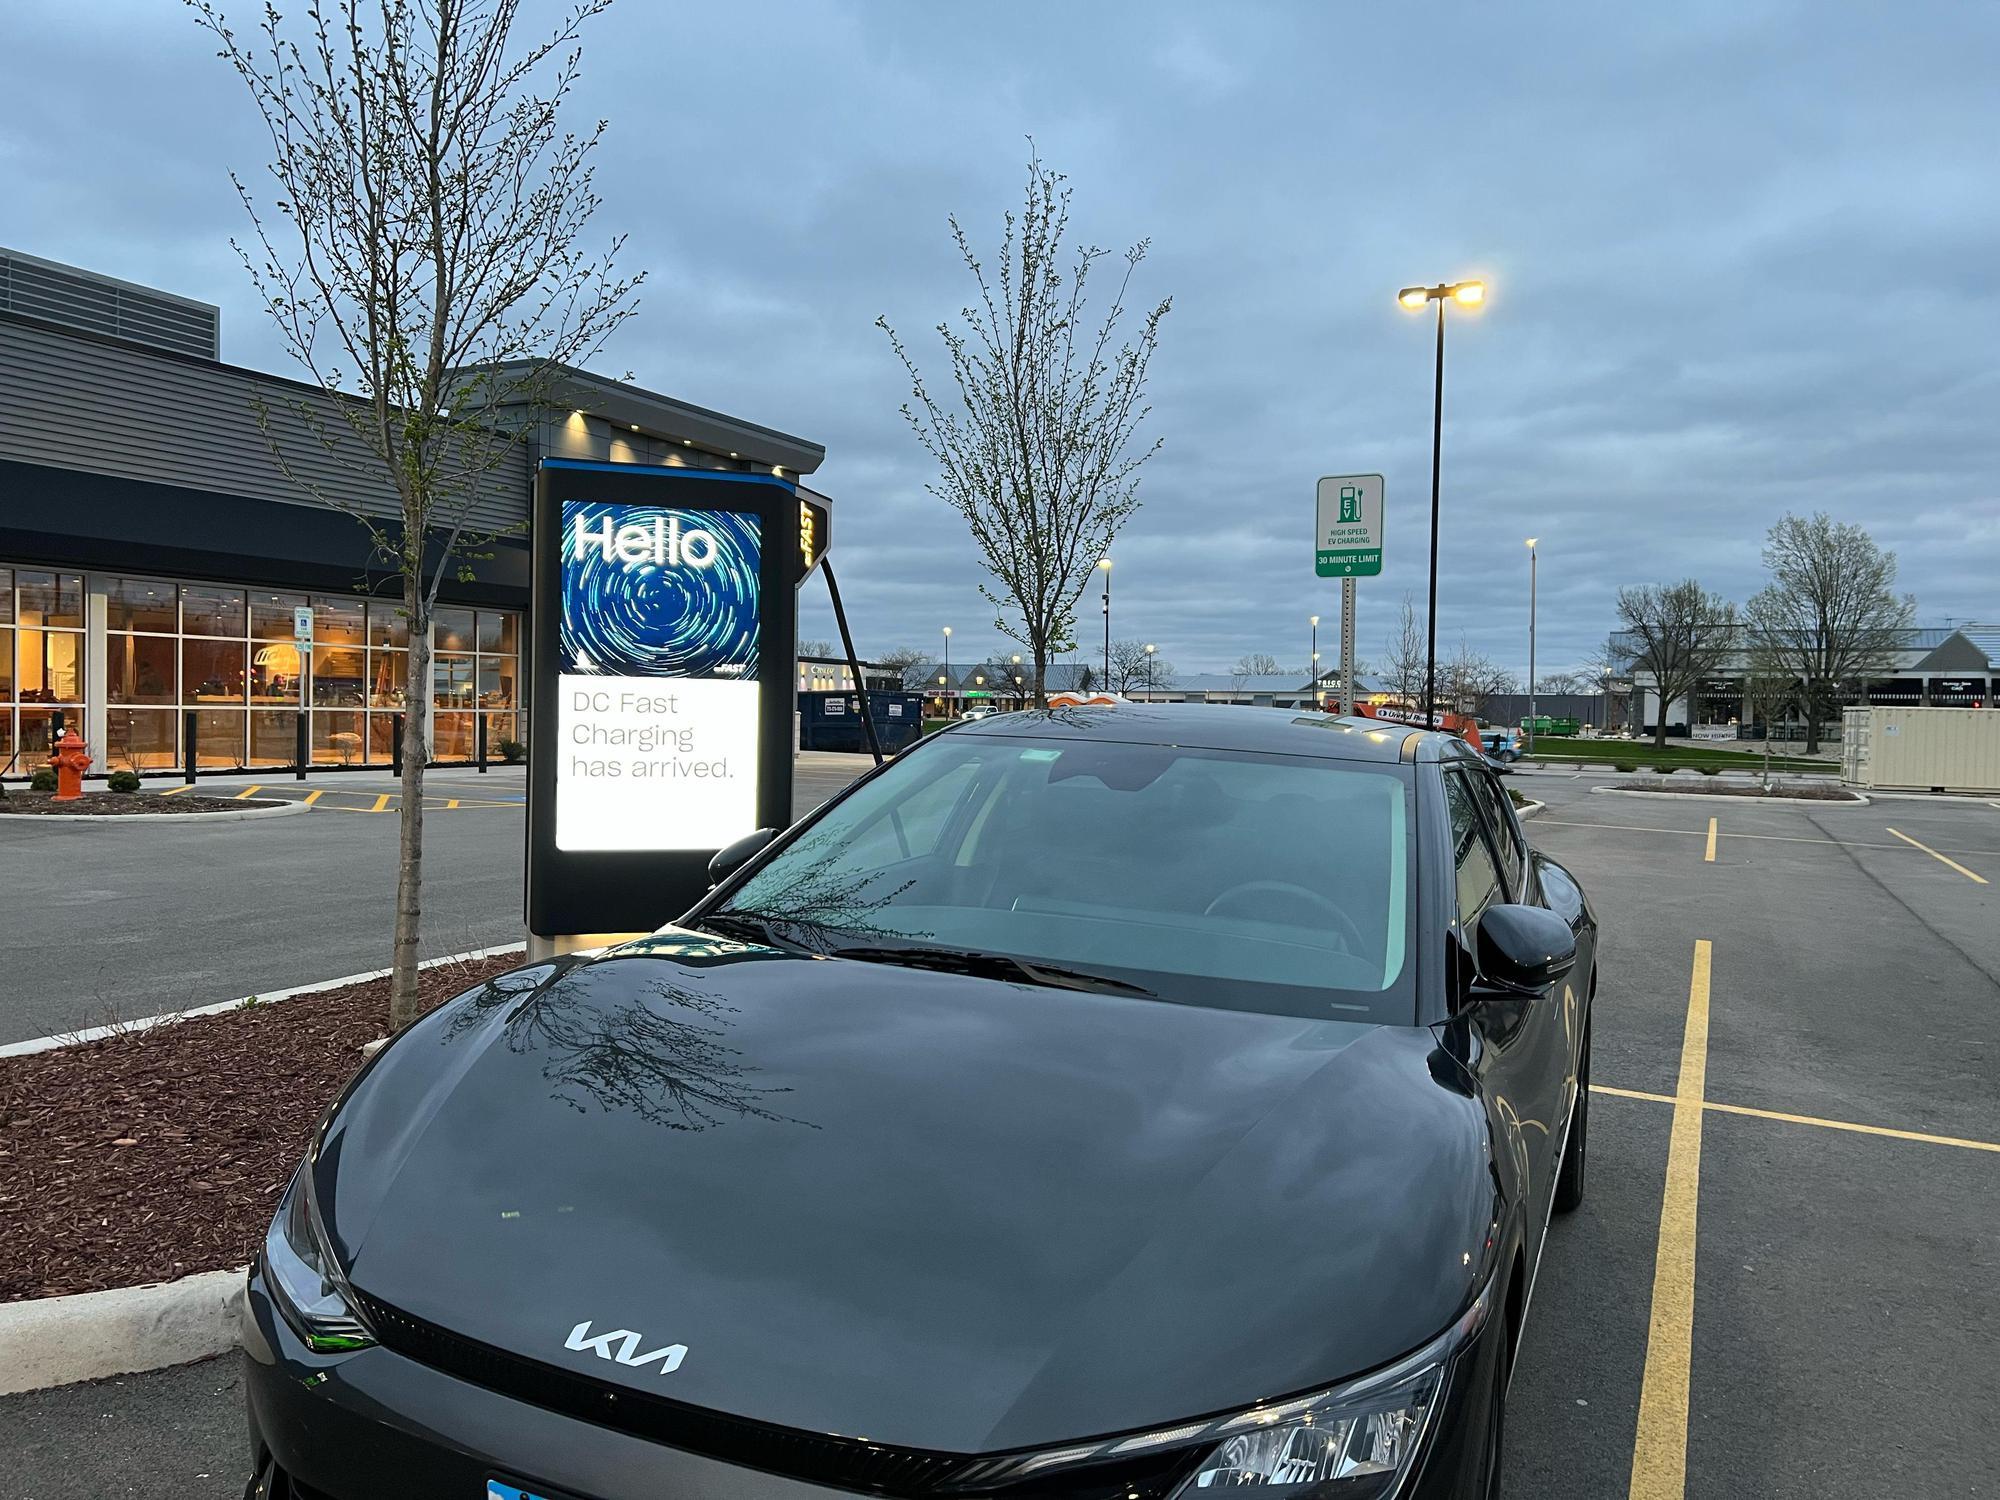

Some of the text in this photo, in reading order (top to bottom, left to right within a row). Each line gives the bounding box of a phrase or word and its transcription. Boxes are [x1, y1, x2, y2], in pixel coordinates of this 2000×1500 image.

[574, 513, 717, 568] Hello
[1318, 554, 1379, 564] 30 MINUTE LIMIT
[573, 691, 679, 714] DC Fast
[572, 723, 694, 753] Charging
[572, 755, 734, 779] has arrived.
[564, 1320, 689, 1375] KIA
